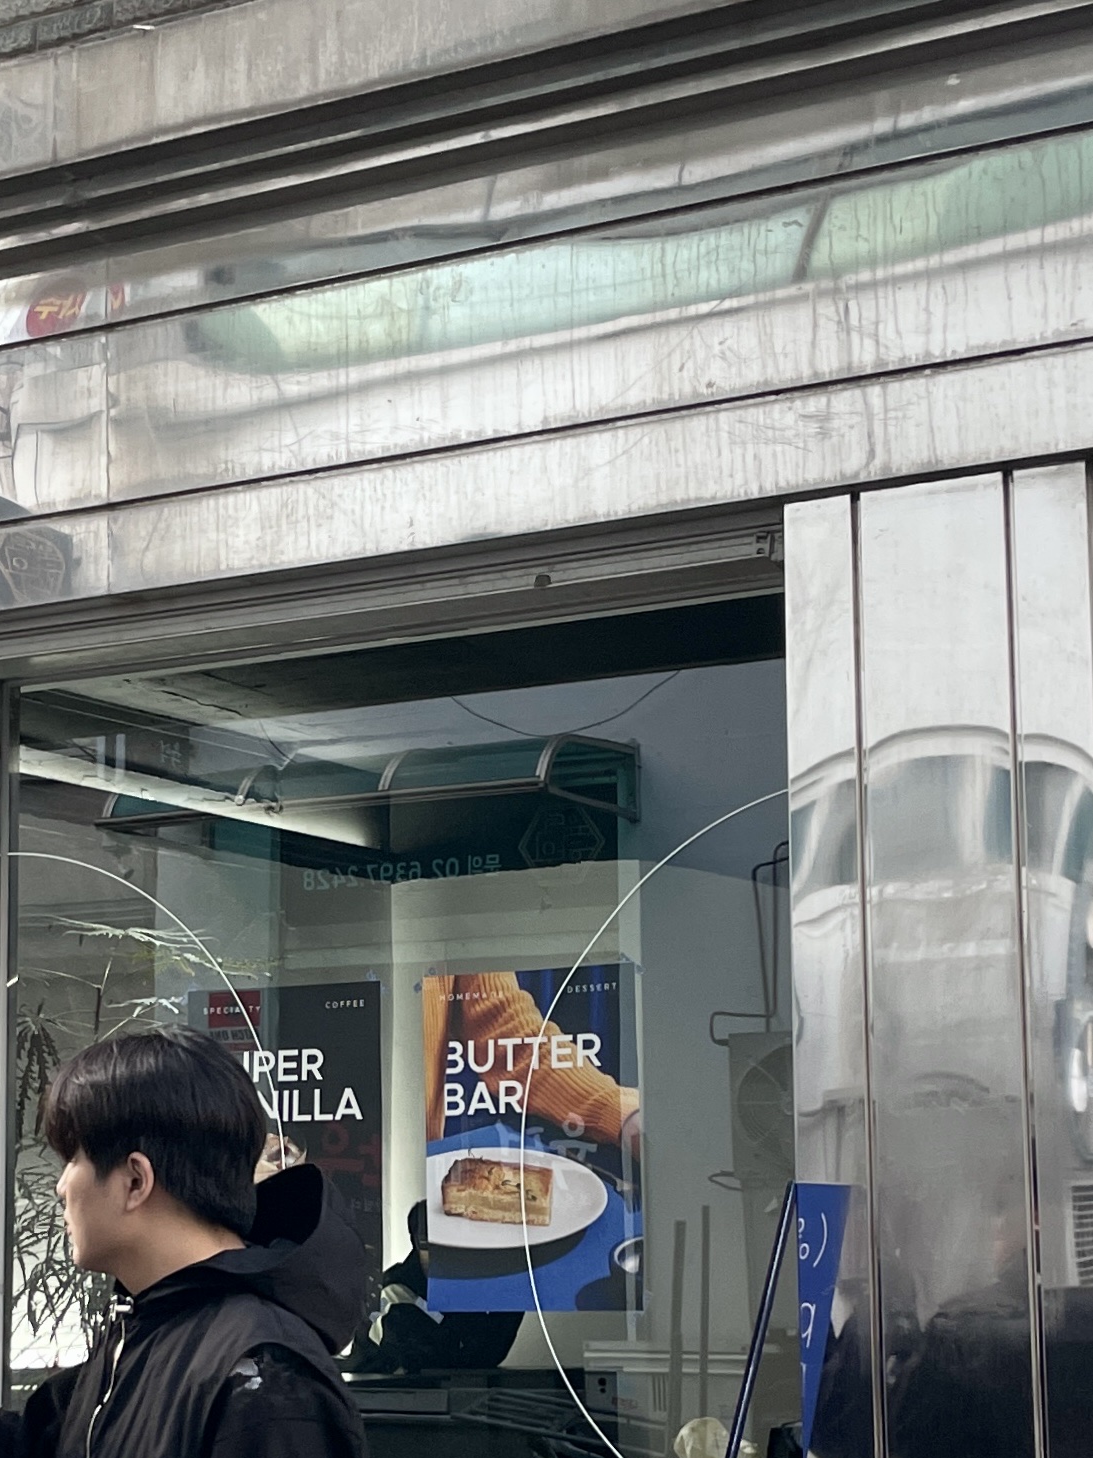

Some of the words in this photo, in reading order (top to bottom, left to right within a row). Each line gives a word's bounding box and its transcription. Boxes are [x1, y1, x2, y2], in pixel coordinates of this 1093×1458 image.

[566, 981, 618, 994] DESSERT
[202, 1005, 261, 1015] SPECIATY
[324, 998, 365, 1009] COFFEE
[445, 1033, 602, 1075] BUTTER
[443, 1079, 523, 1117] BAR
